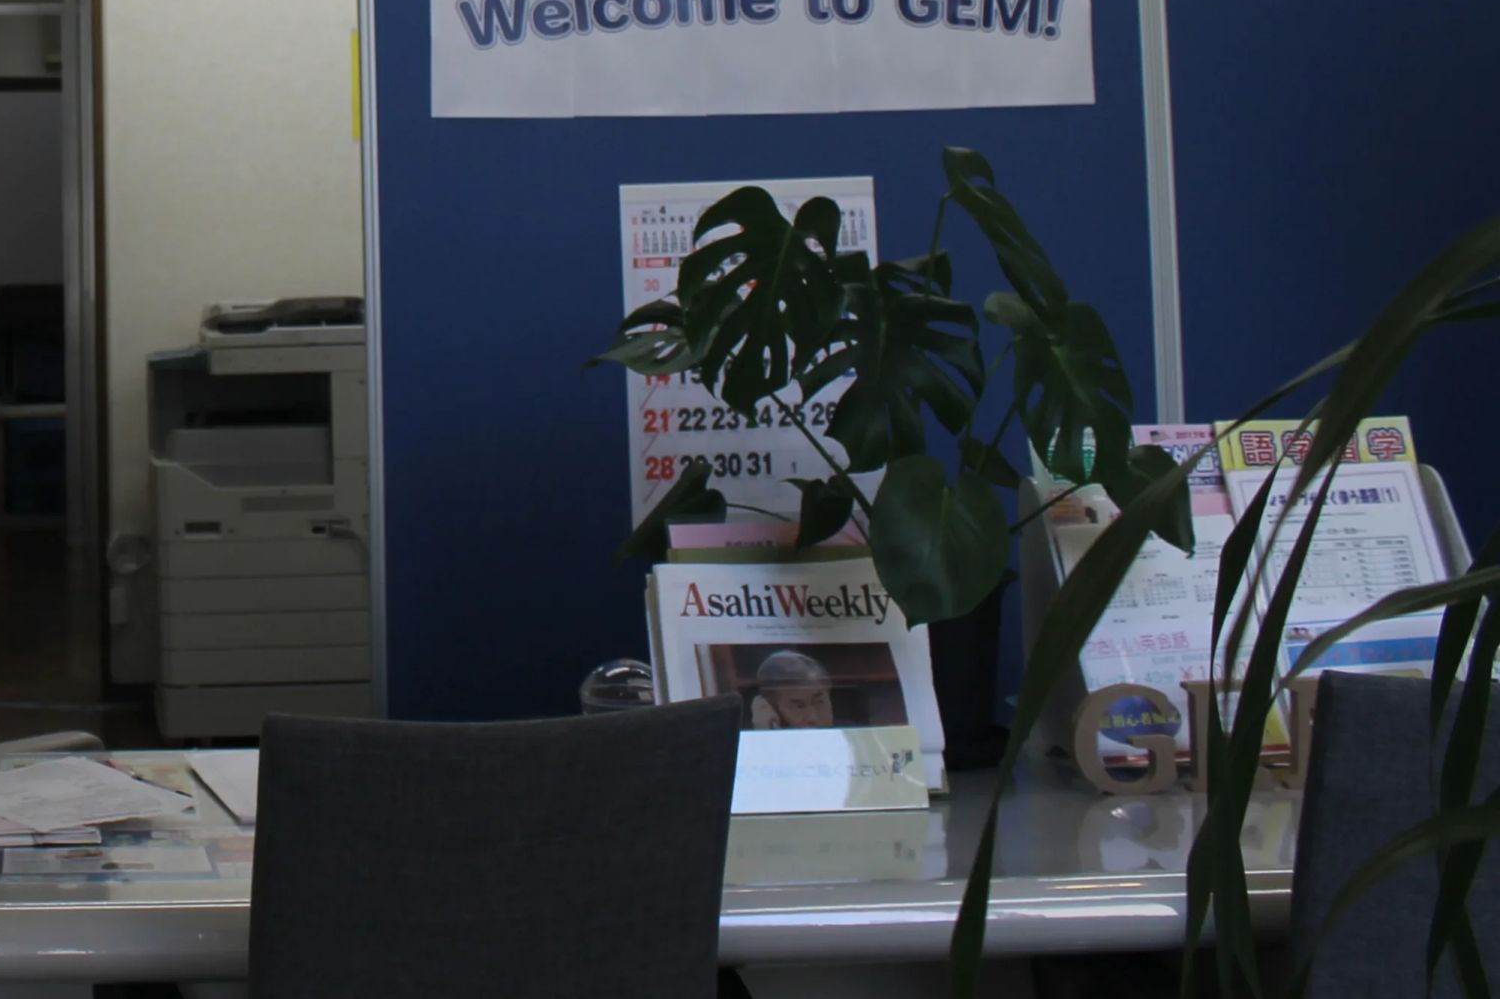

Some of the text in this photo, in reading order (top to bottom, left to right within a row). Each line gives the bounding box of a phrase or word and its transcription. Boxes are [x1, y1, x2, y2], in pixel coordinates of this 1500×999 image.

[643, 278, 661, 292] 30
[643, 409, 669, 433] 21
[678, 407, 707, 432] 22
[711, 406, 740, 430] 23
[644, 456, 675, 480] 28
[713, 453, 742, 478] 30
[746, 452, 772, 476] 31
